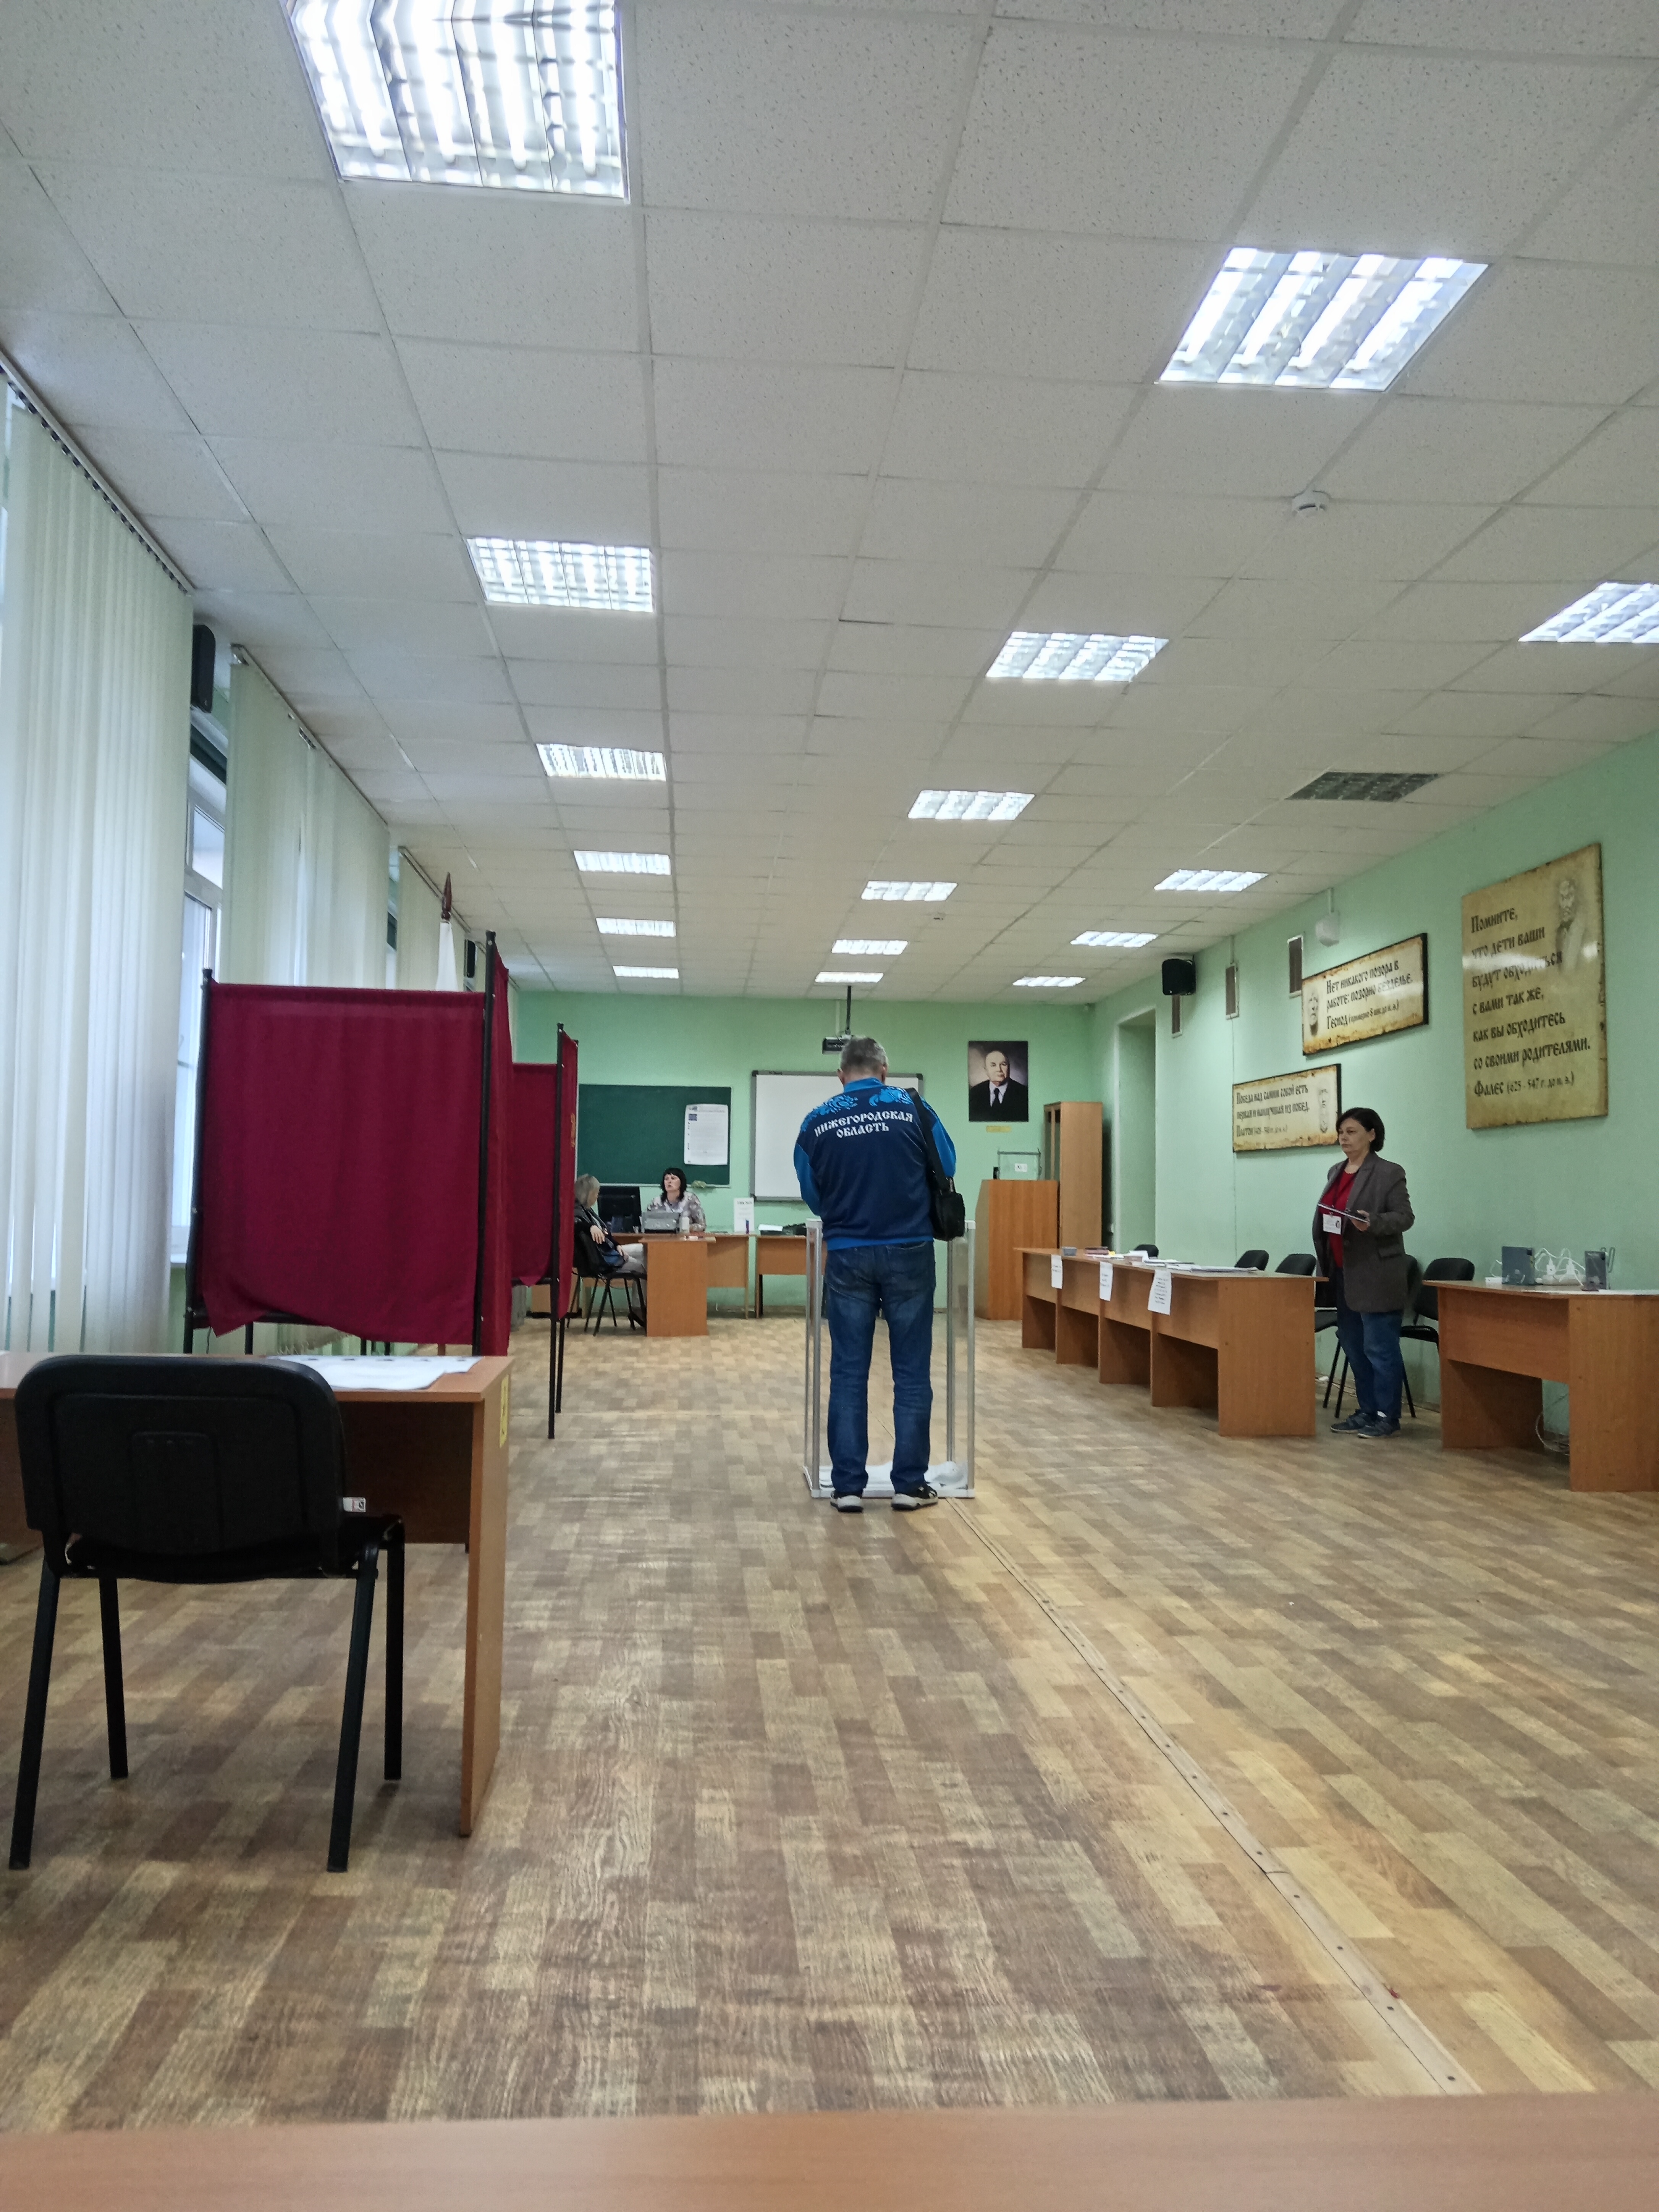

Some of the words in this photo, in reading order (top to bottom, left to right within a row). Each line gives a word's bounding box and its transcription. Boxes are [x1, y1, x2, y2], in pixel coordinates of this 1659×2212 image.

[1471, 908, 1518, 933] Помните,
[1491, 936, 1515, 957] дети
[1518, 927, 1545, 946] ваши
[1326, 980, 1339, 994] Нет
[1473, 1003, 1477, 1014] с
[1480, 997, 1503, 1013] вами
[1506, 991, 1524, 1006] так
[1527, 986, 1544, 1002] же,
[1473, 1028, 1488, 1042] как
[1491, 1025, 1504, 1038] бы
[1507, 1012, 1565, 1038] обходитесь
[1474, 1057, 1483, 1070] со
[1485, 1051, 1519, 1067] своими
[1522, 1037, 1590, 1067] родителями.
[1475, 1080, 1504, 1096] Фалес
[814, 1111, 914, 1137] НИЖЕГОРОДСКАЯ
[836, 1122, 889, 1138] ОБЛАСТЬ
